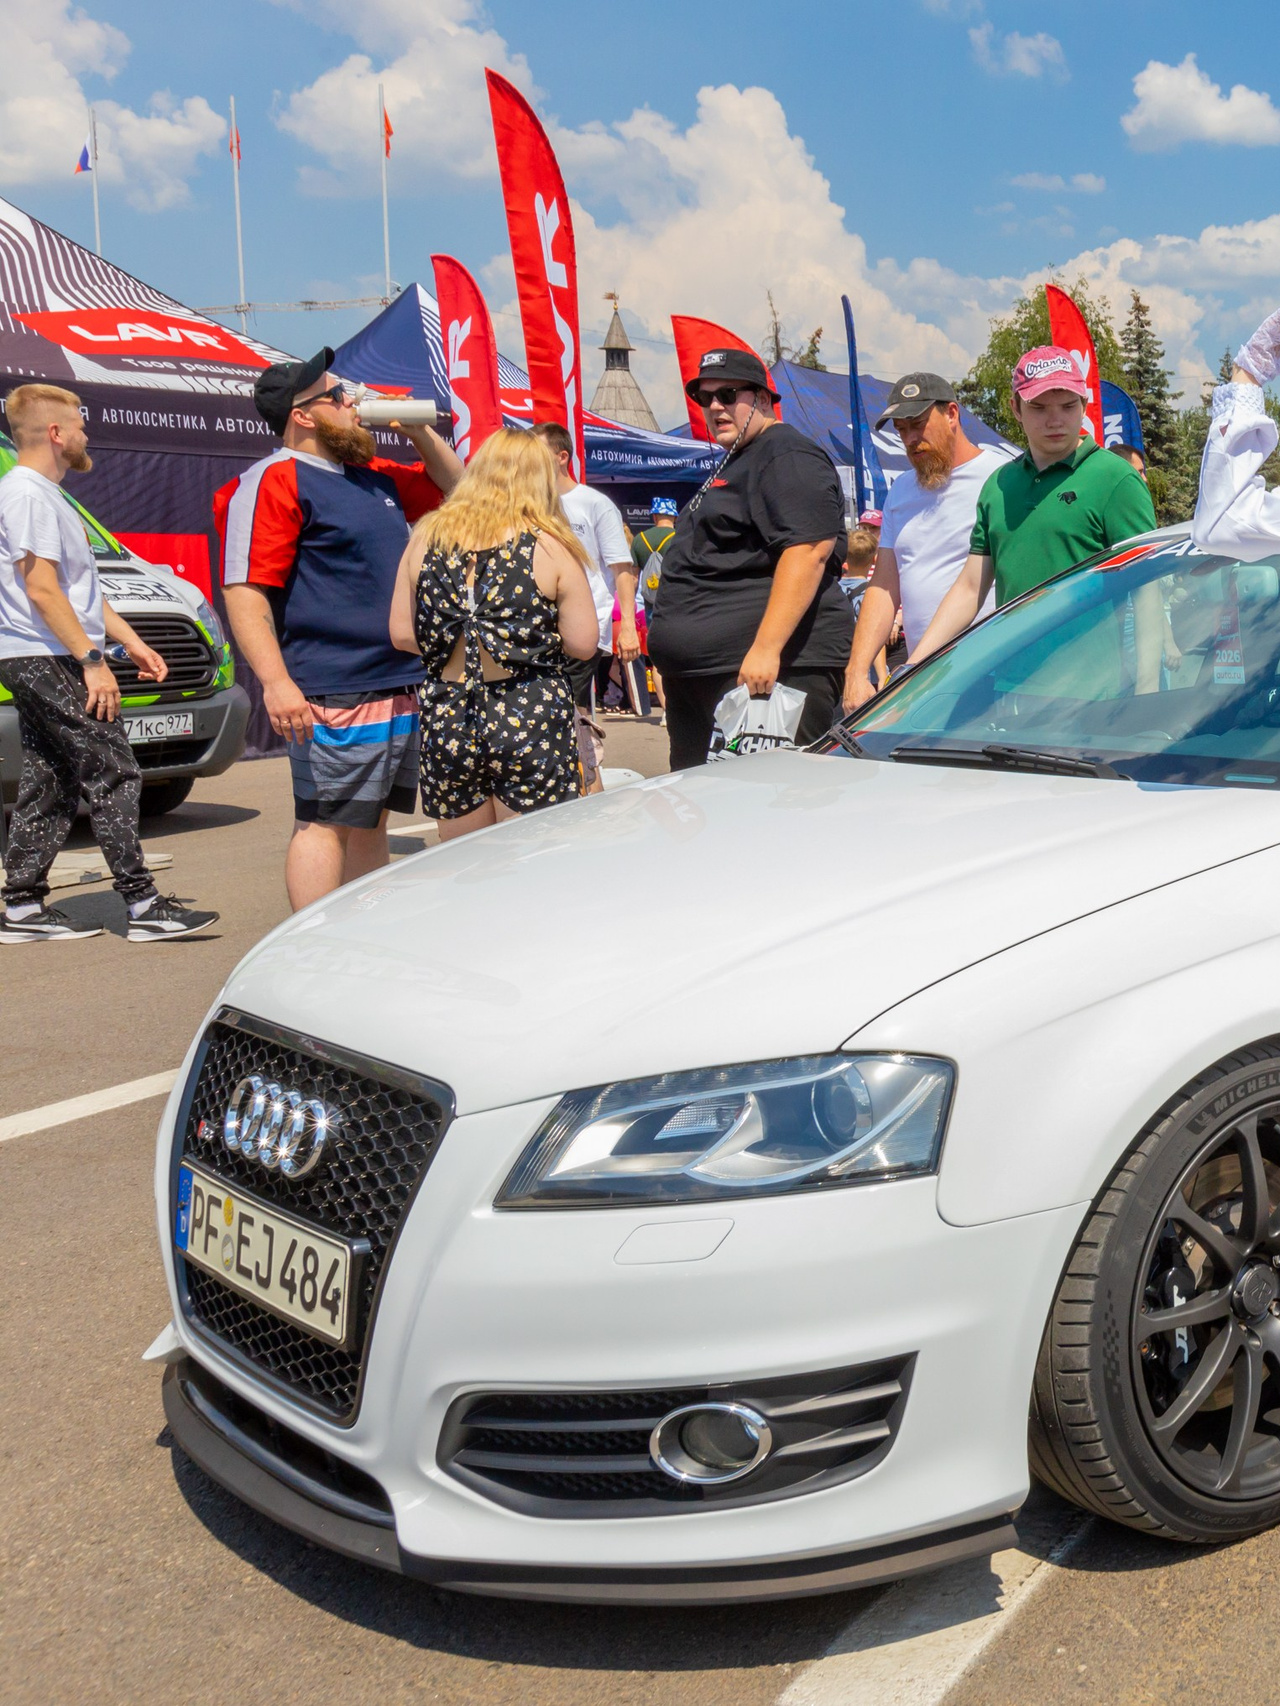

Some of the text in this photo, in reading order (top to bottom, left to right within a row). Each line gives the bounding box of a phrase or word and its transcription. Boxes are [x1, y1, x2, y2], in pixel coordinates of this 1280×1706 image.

[68, 323, 228, 350] LAVR
[121, 358, 176, 370] Твое
[1026, 357, 1068, 376] Orlando
[102, 408, 207, 431] АВТОКОСМЕТИКА
[591, 449, 643, 465] АВТОХИМИЯ
[167, 714, 188, 729] 977
[191, 1183, 341, 1326] PF EJ 484
